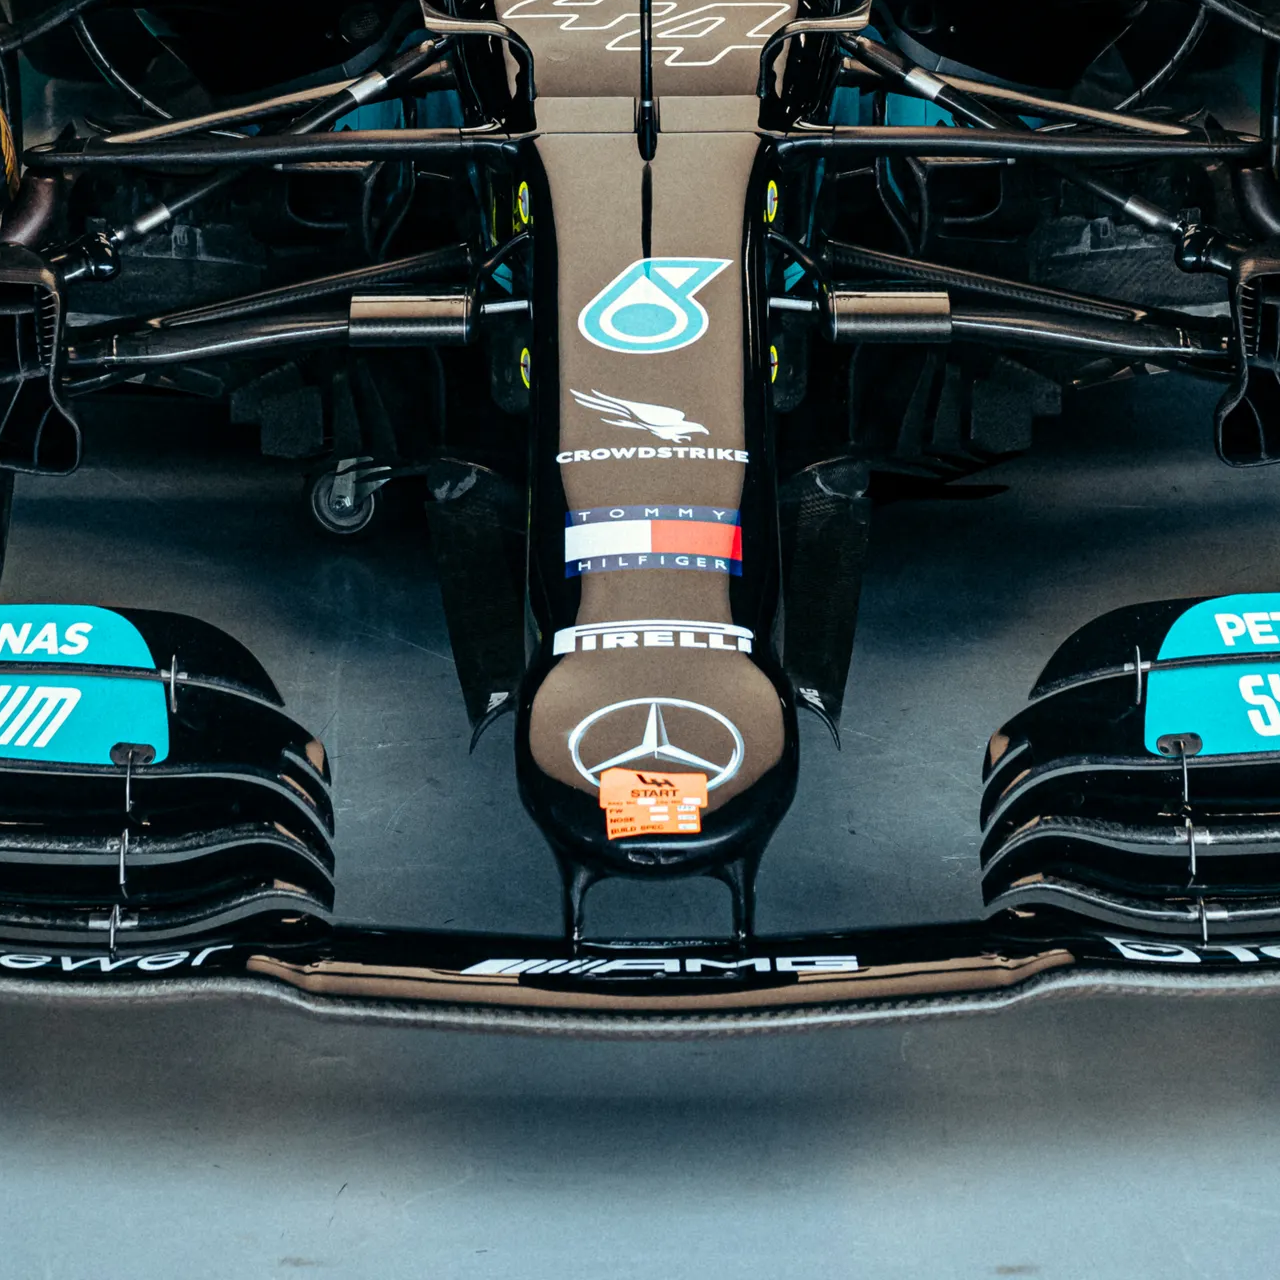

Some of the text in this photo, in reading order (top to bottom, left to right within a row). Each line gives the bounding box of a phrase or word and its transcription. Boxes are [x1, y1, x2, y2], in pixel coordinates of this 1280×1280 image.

[556, 446, 750, 464] CROWDSTRIKE
[578, 507, 726, 522] TOMMY
[578, 555, 728, 572] HILFIGER
[552, 619, 756, 657] PIRELLI
[631, 789, 680, 798] START
[582, 954, 858, 974] AMG
